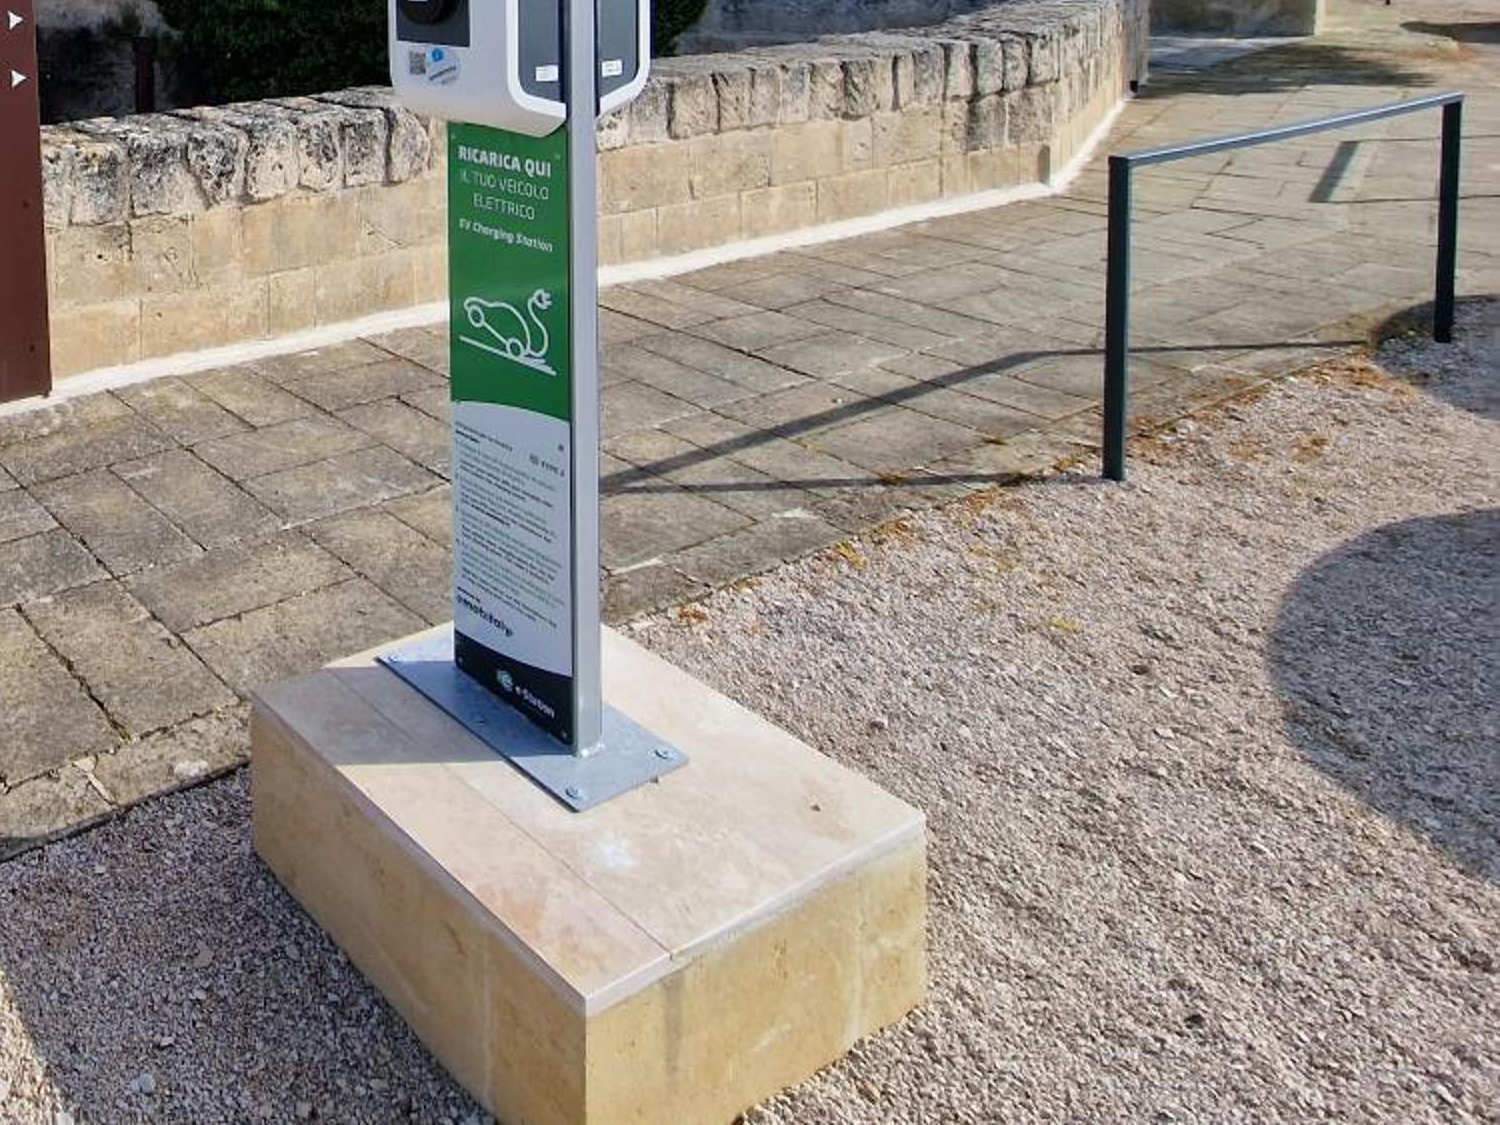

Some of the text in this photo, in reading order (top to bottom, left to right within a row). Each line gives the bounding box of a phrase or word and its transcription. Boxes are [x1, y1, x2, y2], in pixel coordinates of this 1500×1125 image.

[458, 145, 551, 179] RICARICA QUI
[471, 170, 497, 189] TUO
[499, 177, 550, 201] VEICOLO
[473, 192, 536, 221] ELETTRICO
[515, 232, 554, 253] Station
